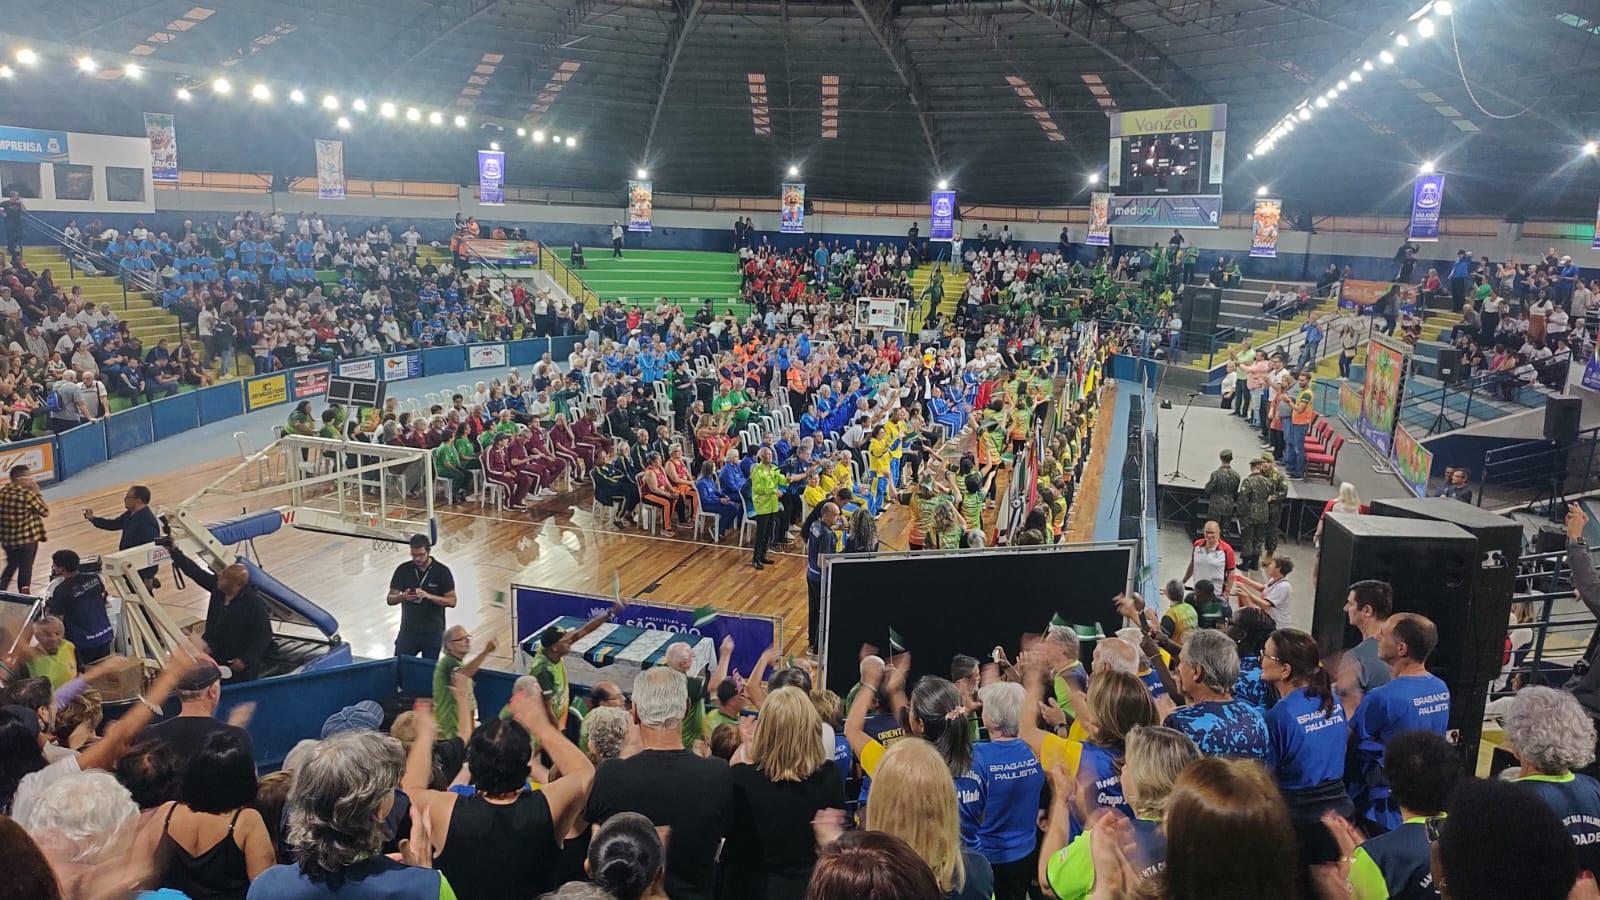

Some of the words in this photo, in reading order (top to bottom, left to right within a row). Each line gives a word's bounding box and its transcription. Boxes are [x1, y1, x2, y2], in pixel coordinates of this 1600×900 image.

[1135, 113, 1198, 131] Vanzela
[0, 140, 43, 153] MPRENSA
[152, 160, 177, 168] URACO
[1114, 205, 1158, 218] medway
[645, 616, 679, 625] PREFEITURA
[1418, 703, 1449, 716] PAULISTA
[1304, 715, 1344, 734] PAULISTA
[877, 728, 904, 741] ORIENT
[994, 767, 1038, 781] PAULISTA
[1571, 831, 1600, 846] DADE
